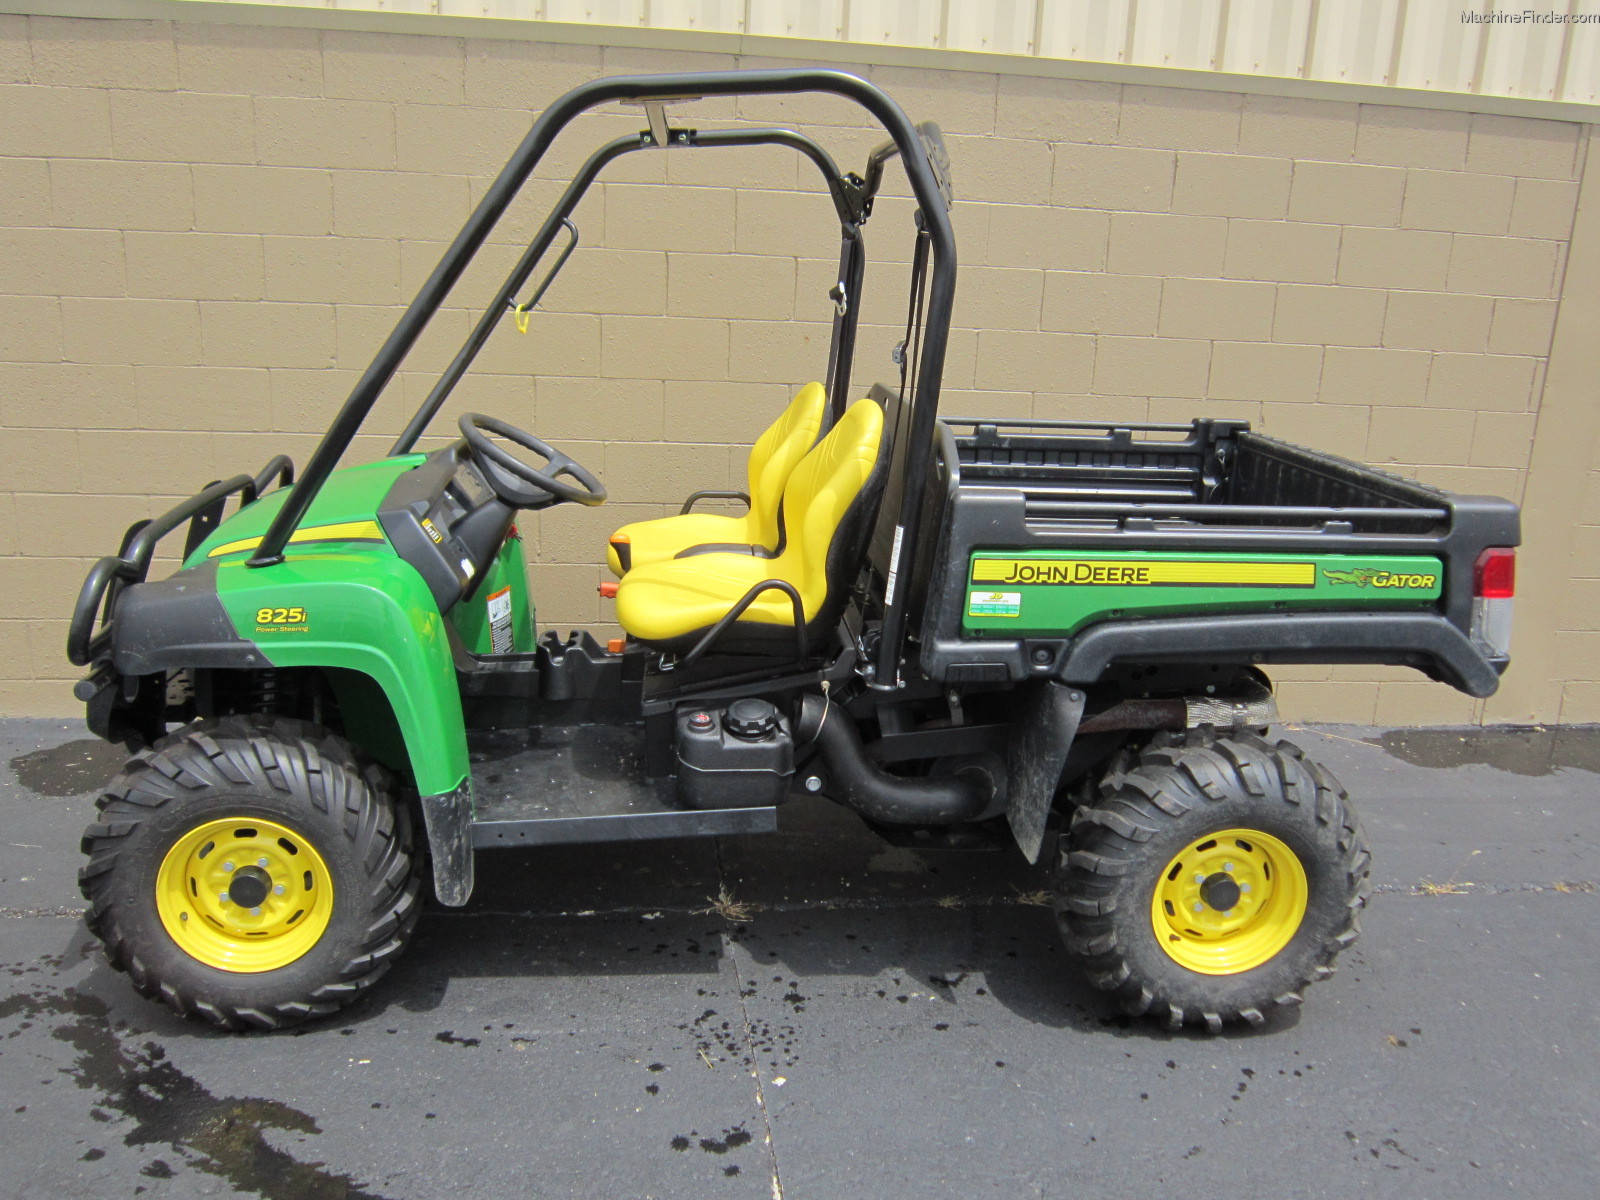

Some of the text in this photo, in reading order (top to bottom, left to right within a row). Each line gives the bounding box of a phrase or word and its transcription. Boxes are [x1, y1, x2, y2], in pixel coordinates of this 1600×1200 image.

[1004, 563, 1150, 582] JOHN DEERE
[1371, 570, 1436, 589] GATOR
[256, 607, 307, 624] 825i
